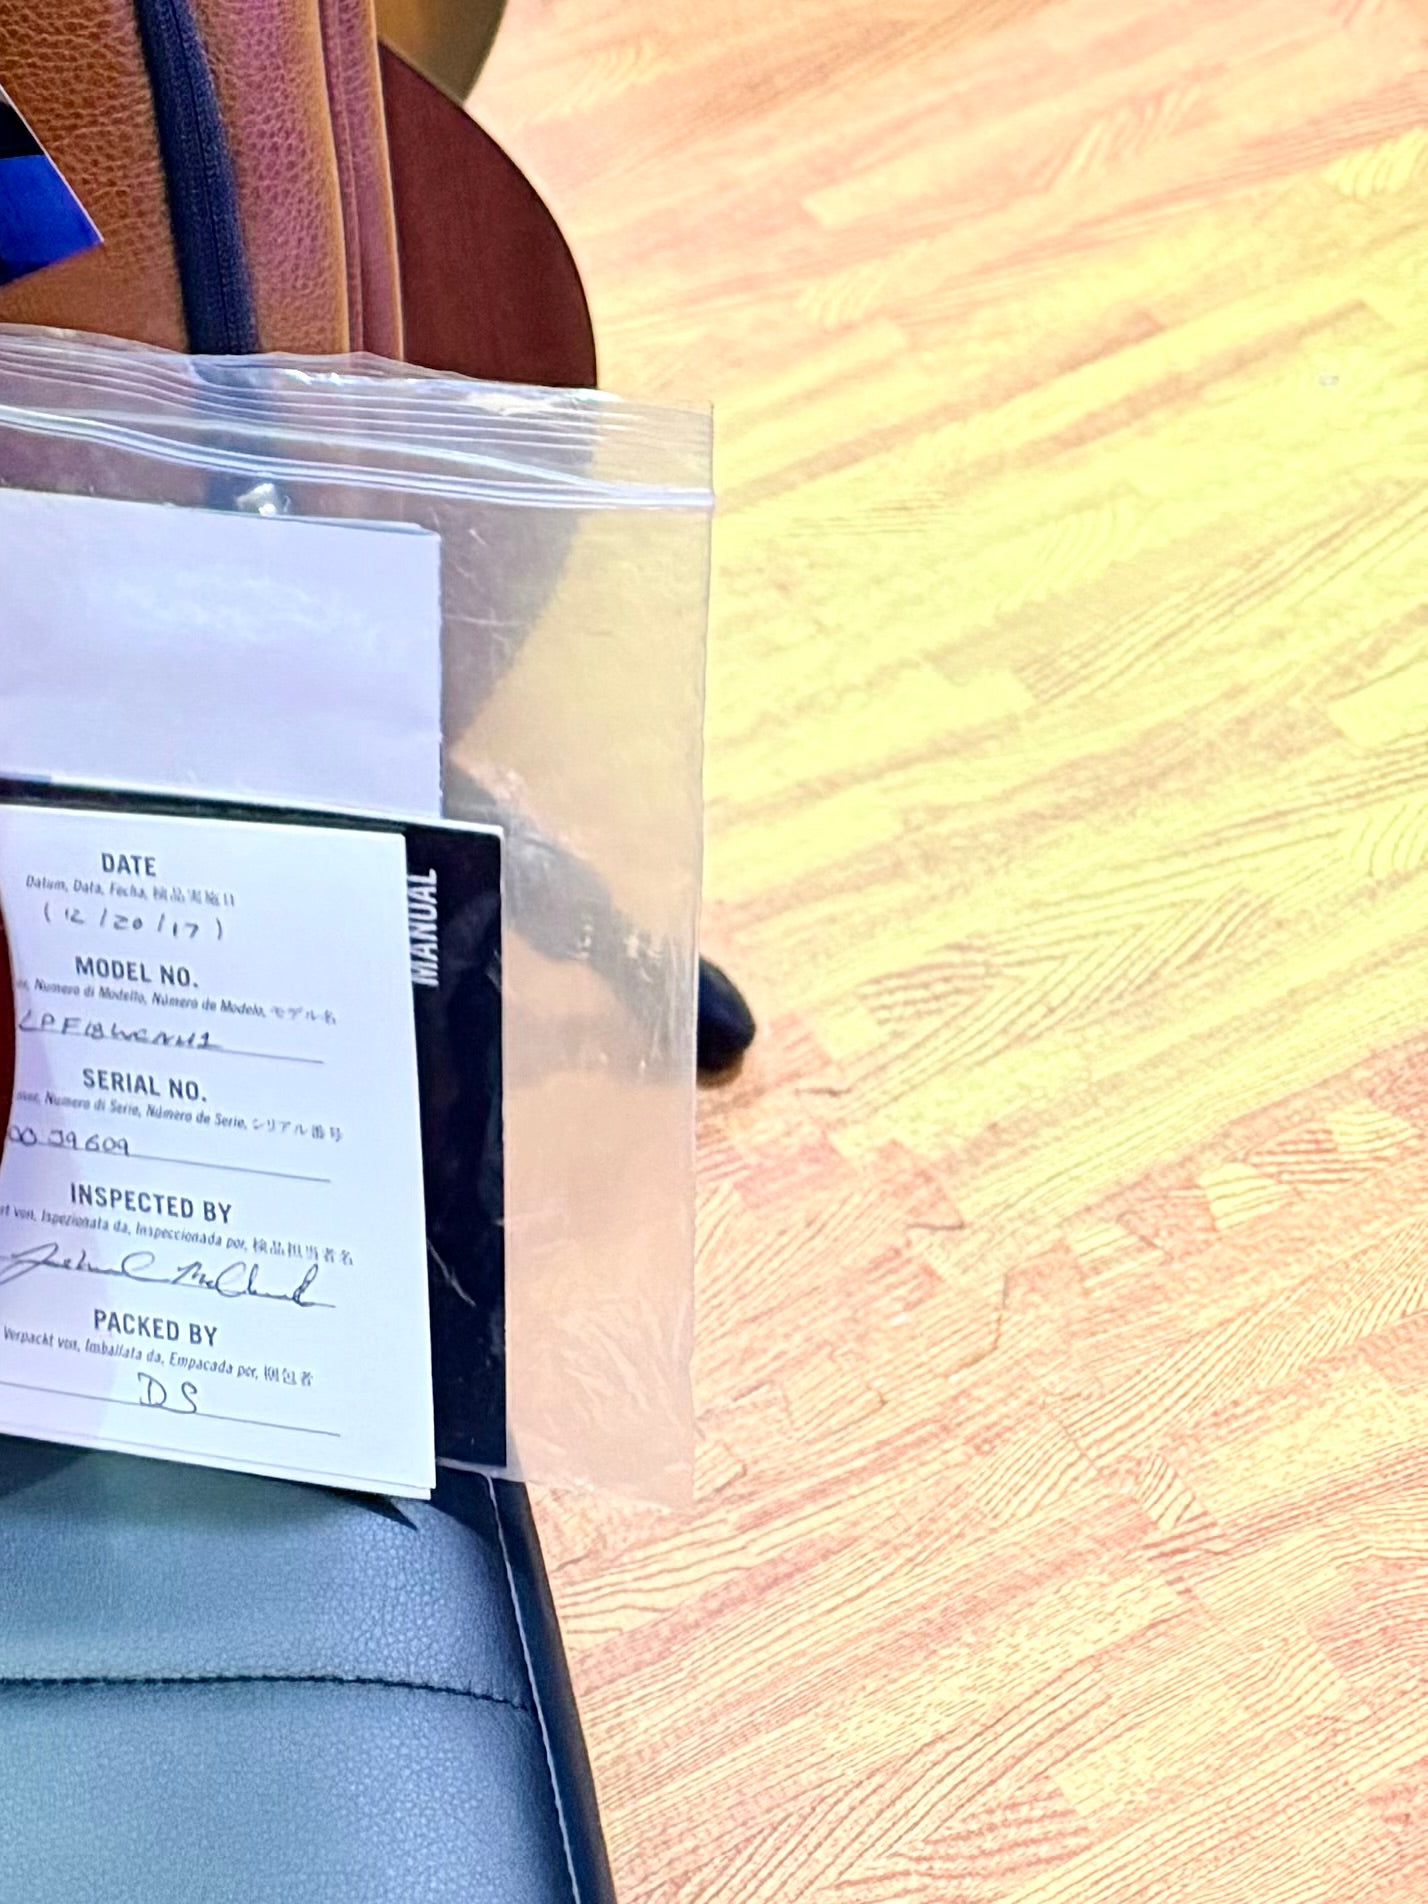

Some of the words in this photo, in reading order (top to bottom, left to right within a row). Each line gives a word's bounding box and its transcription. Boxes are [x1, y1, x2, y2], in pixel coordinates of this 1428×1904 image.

[101, 852, 157, 877] DATE
[407, 868, 439, 988] MANUAL
[74, 956, 152, 984] MODEL
[160, 965, 200, 988] NO.
[82, 1068, 161, 1097] SERIAL
[168, 1078, 208, 1103] NO.
[70, 1182, 195, 1219] INSPECTED
[203, 1201, 232, 1224] BY
[93, 1309, 180, 1342] PACKED
[188, 1323, 219, 1347] BY
